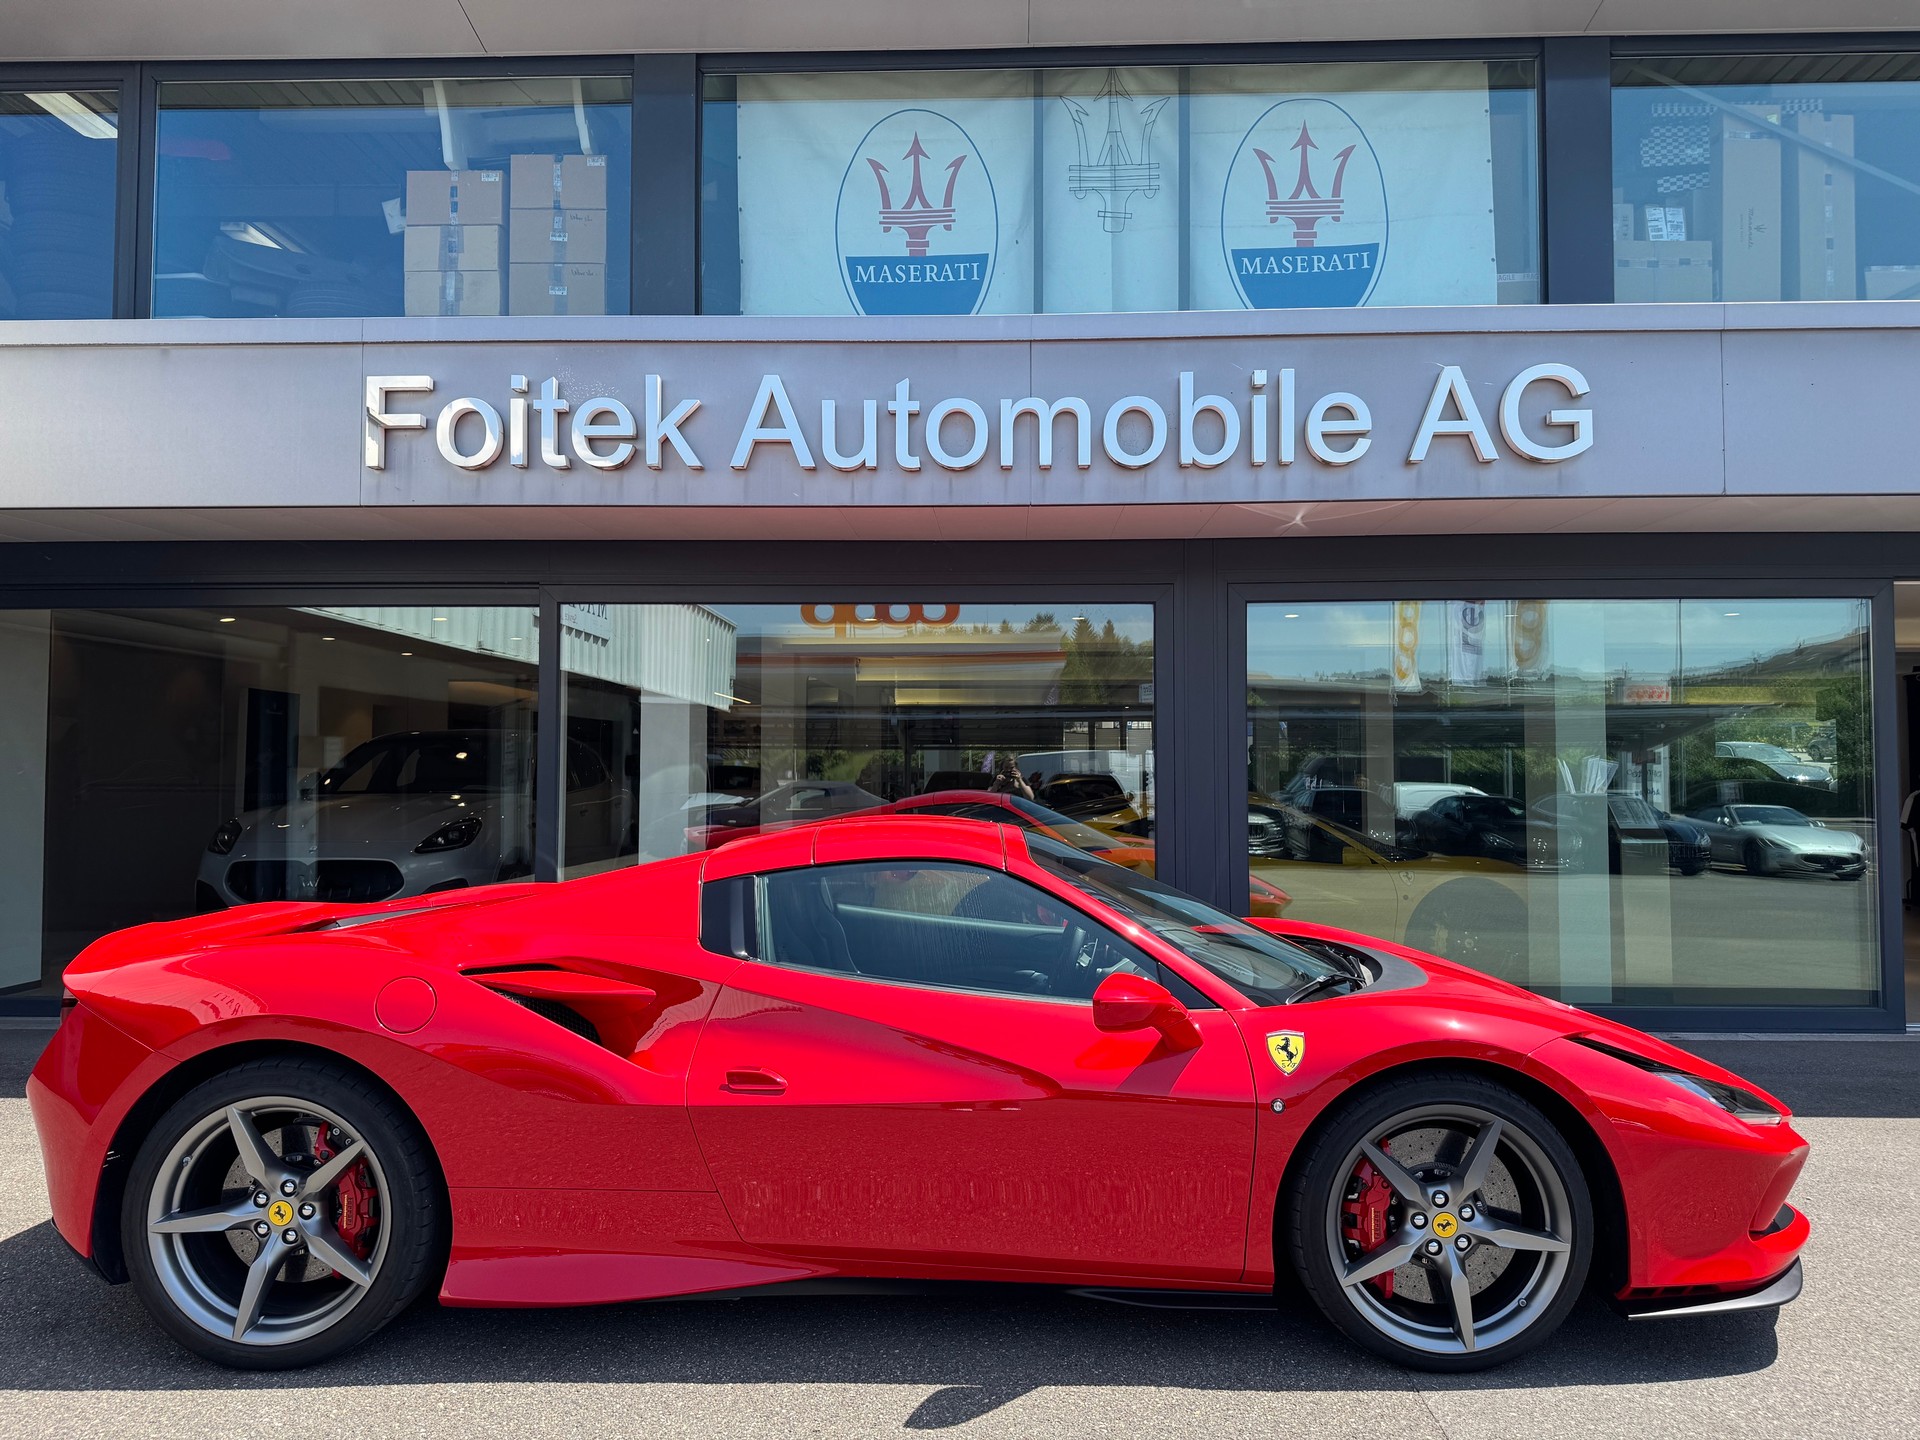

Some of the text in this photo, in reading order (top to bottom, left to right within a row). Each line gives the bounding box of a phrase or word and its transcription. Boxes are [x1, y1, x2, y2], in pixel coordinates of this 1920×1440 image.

[855, 262, 980, 283] MASERATI
[1240, 251, 1371, 275] MASERATI
[364, 363, 1594, 472] Foitek Automobile AG
